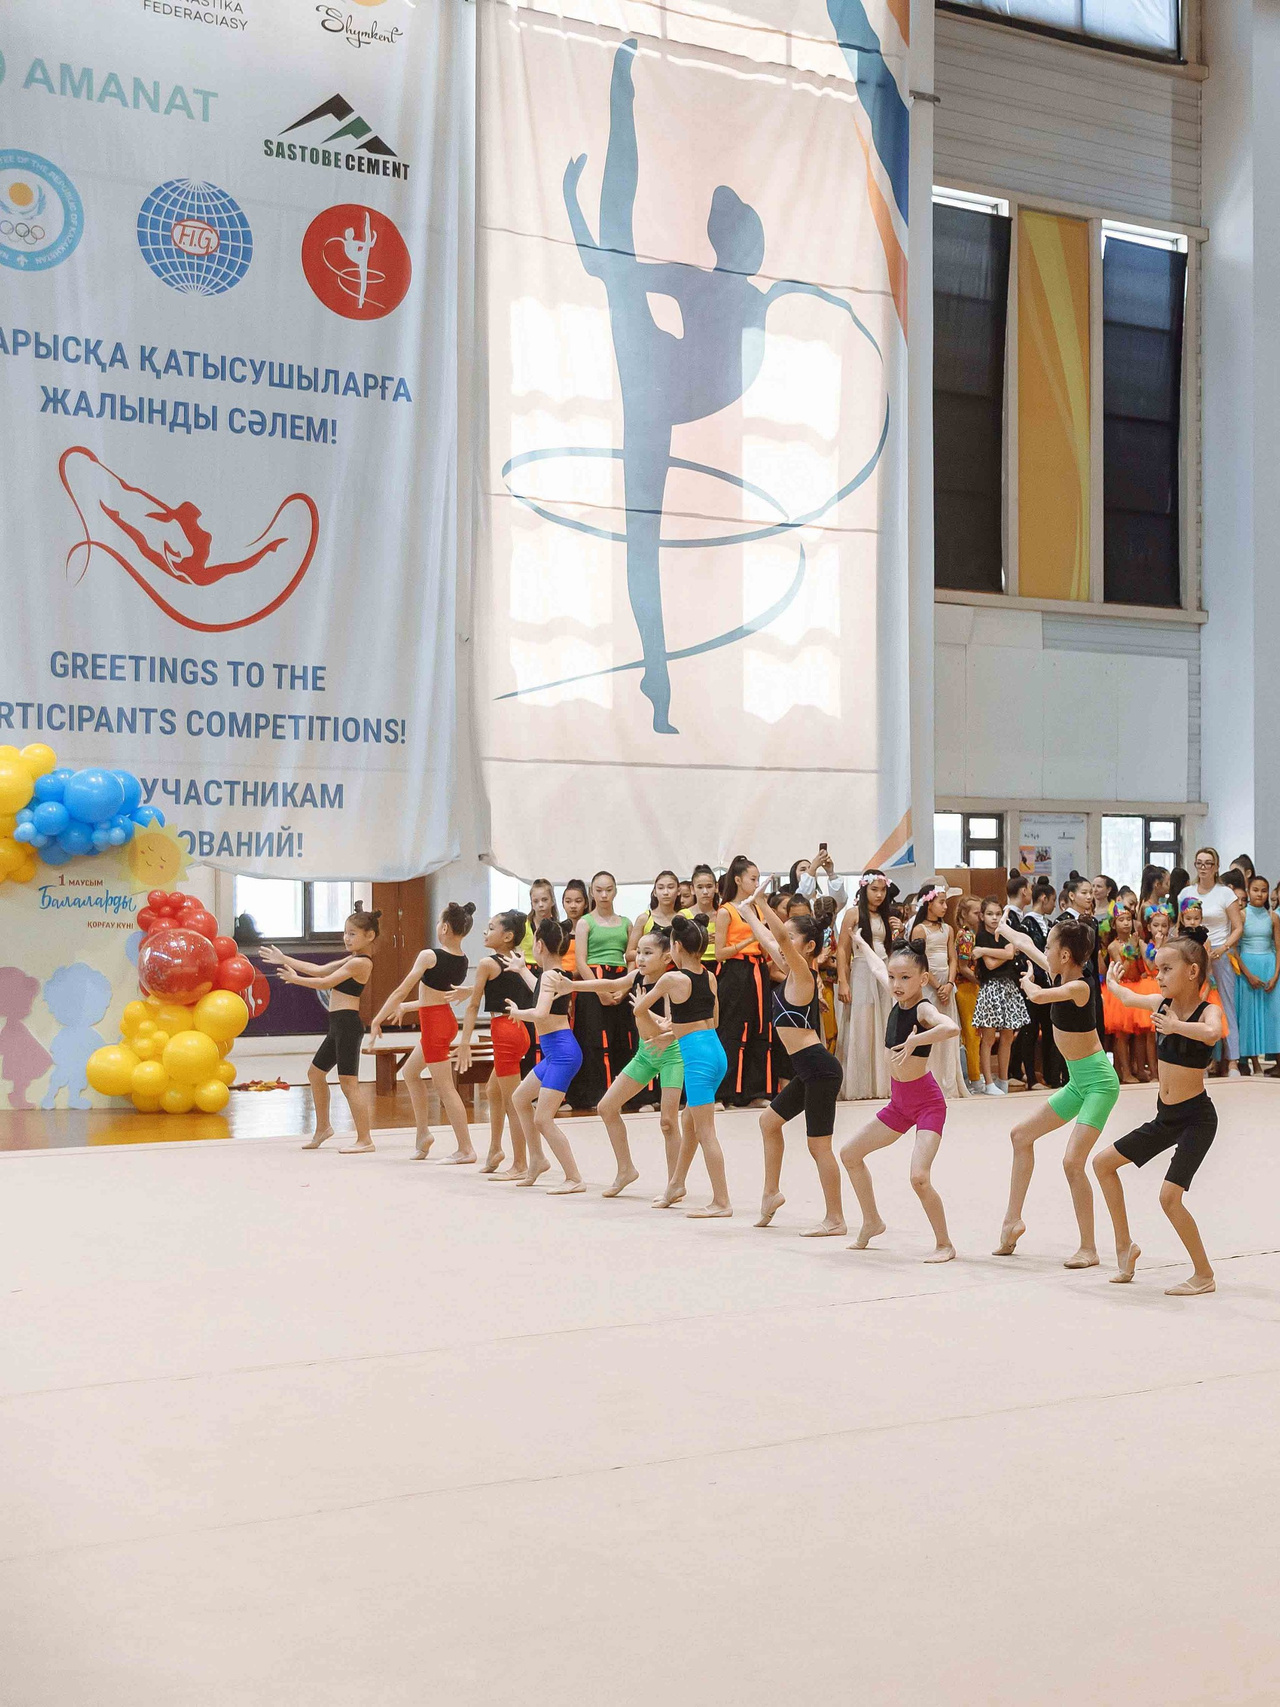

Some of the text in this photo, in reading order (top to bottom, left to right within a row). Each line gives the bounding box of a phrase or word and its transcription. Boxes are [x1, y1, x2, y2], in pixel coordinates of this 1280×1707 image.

[143, 0, 248, 31] FEDERACIASY
[315, 4, 404, 48] Shymkent
[23, 58, 218, 123] AMANAT
[263, 139, 410, 180] SASTOBE CEMENT
[140, 345, 412, 402] ҚАТЫСУШЫЛАРҒА
[40, 385, 338, 444] ЖАЛЫНДЫ СӘЛЕМ!
[50, 650, 327, 692] GREETINGS TO THE
[186, 710, 407, 744] COMPETITIONS!
[140, 777, 344, 809] УЧАСТНИКАМ
[38, 885, 137, 914] Балаларды
[58, 874, 66, 886] 1
